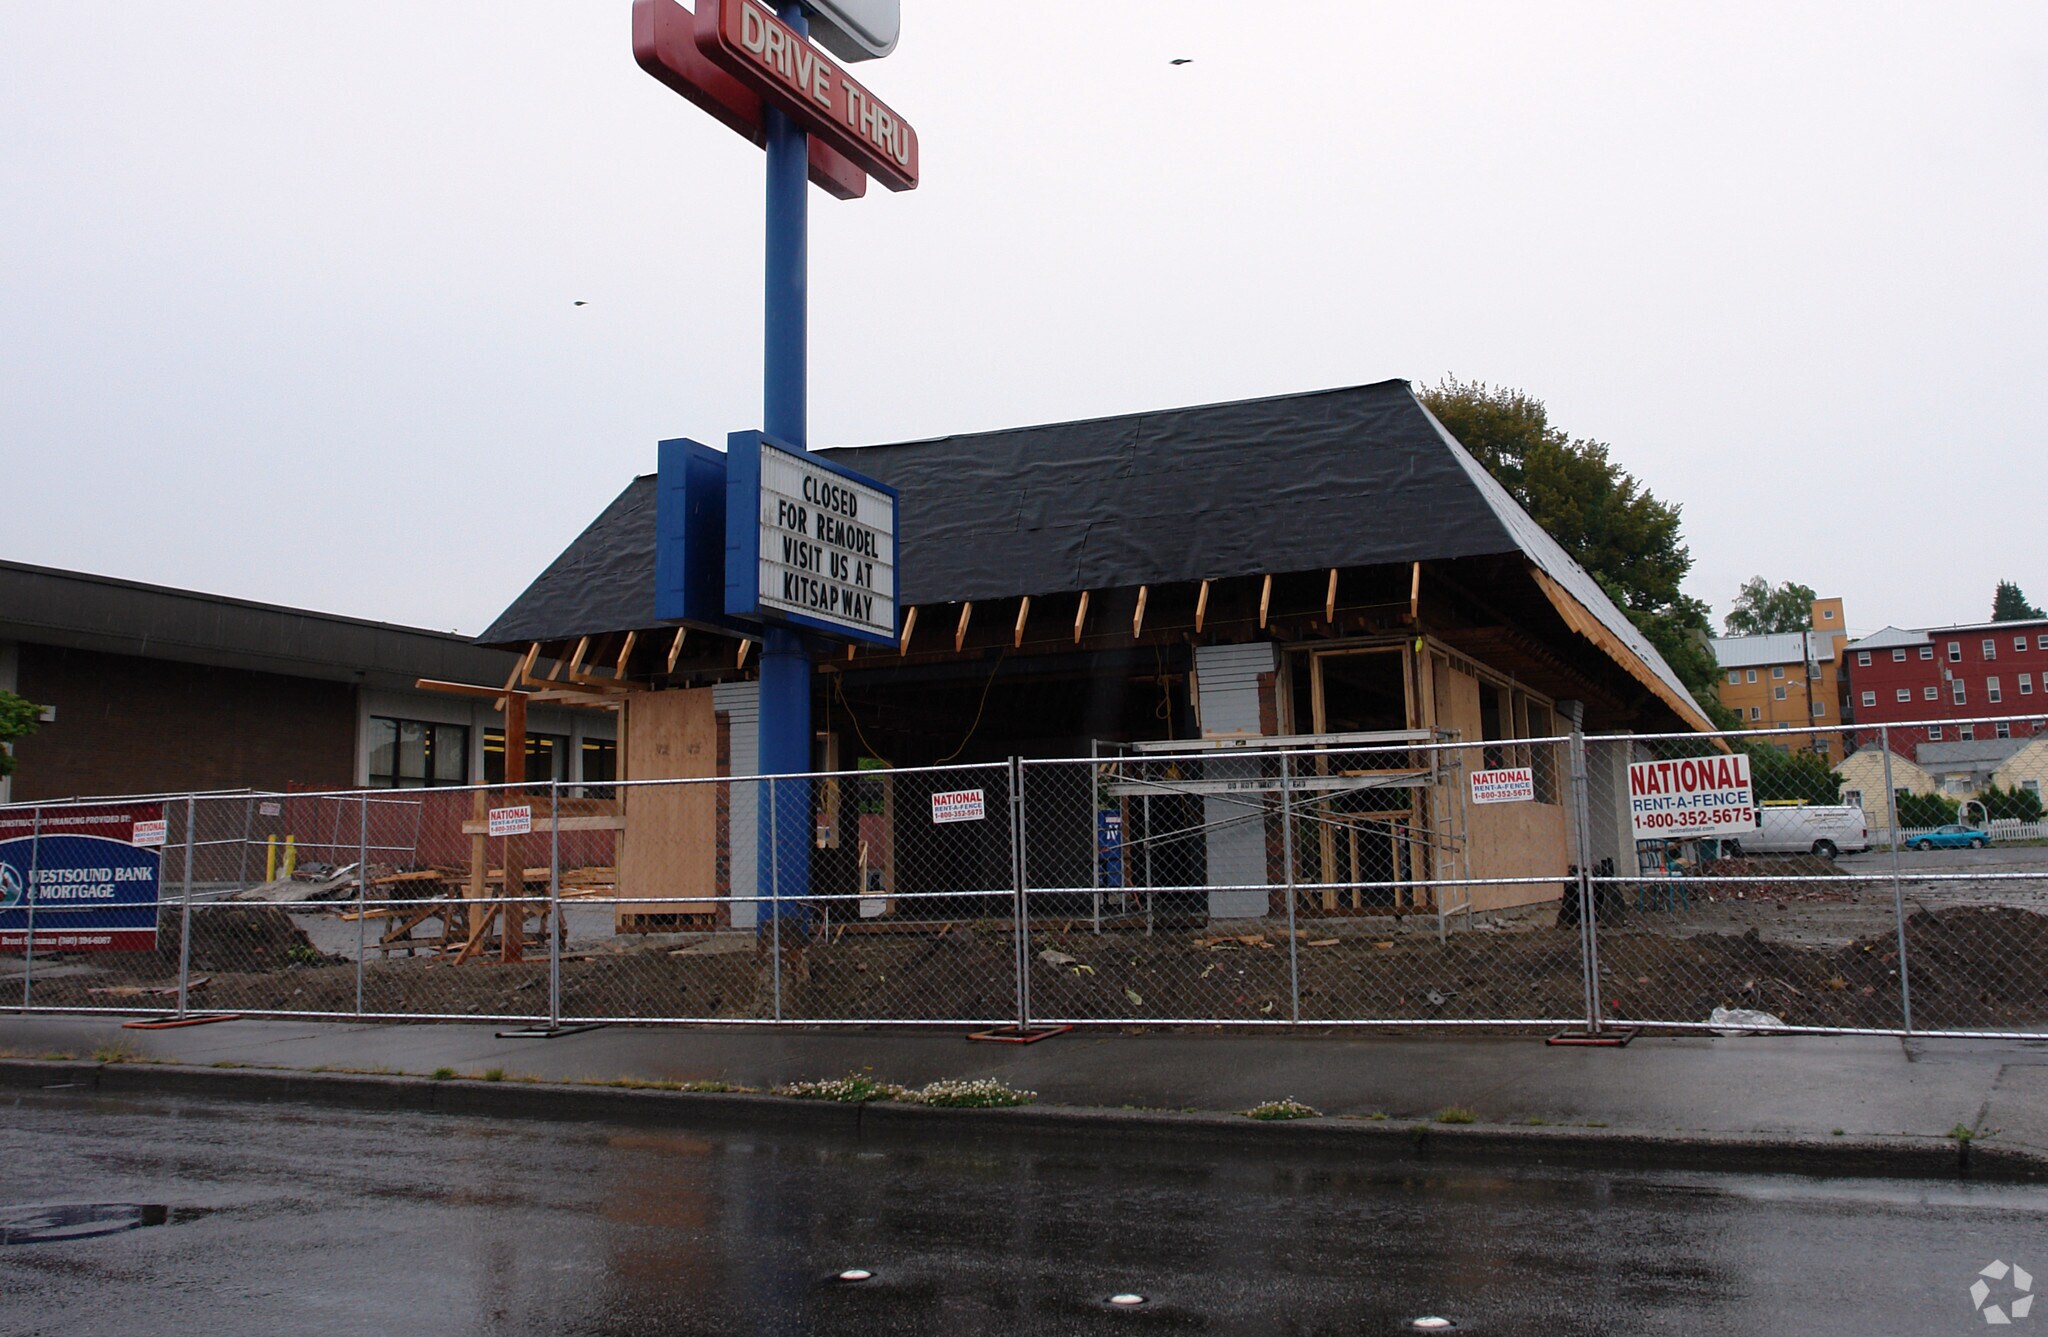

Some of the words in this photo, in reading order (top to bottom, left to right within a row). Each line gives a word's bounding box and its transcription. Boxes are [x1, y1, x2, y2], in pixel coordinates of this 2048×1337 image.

[741, 2, 831, 108] DRIVE
[841, 79, 909, 166] THRU
[803, 475, 858, 518] CLOSED
[779, 499, 807, 534] FOR
[817, 513, 878, 558] REMODEL
[783, 536, 822, 573] VISIT
[831, 552, 848, 581] US
[855, 560, 872, 588] AT
[1472, 770, 1530, 785] NATIONAL
[1630, 757, 1748, 796] NATIONAL
[1474, 782, 1530, 791] RENT-A-FENCE
[1474, 789, 1532, 799] 1-800-352-5675
[933, 791, 982, 806] NATIONAL
[1633, 791, 1748, 811] RENT-A-FENCE
[490, 808, 529, 820] NATIONAL
[934, 803, 982, 812] RENT-A-FENCE
[935, 809, 983, 818] 1-800-352-5675
[1634, 807, 1753, 829] 1-800-352-5675
[134, 823, 166, 832] NATIONAL
[114, 866, 153, 881] BANK
[39, 884, 115, 899] MORTGAGE
